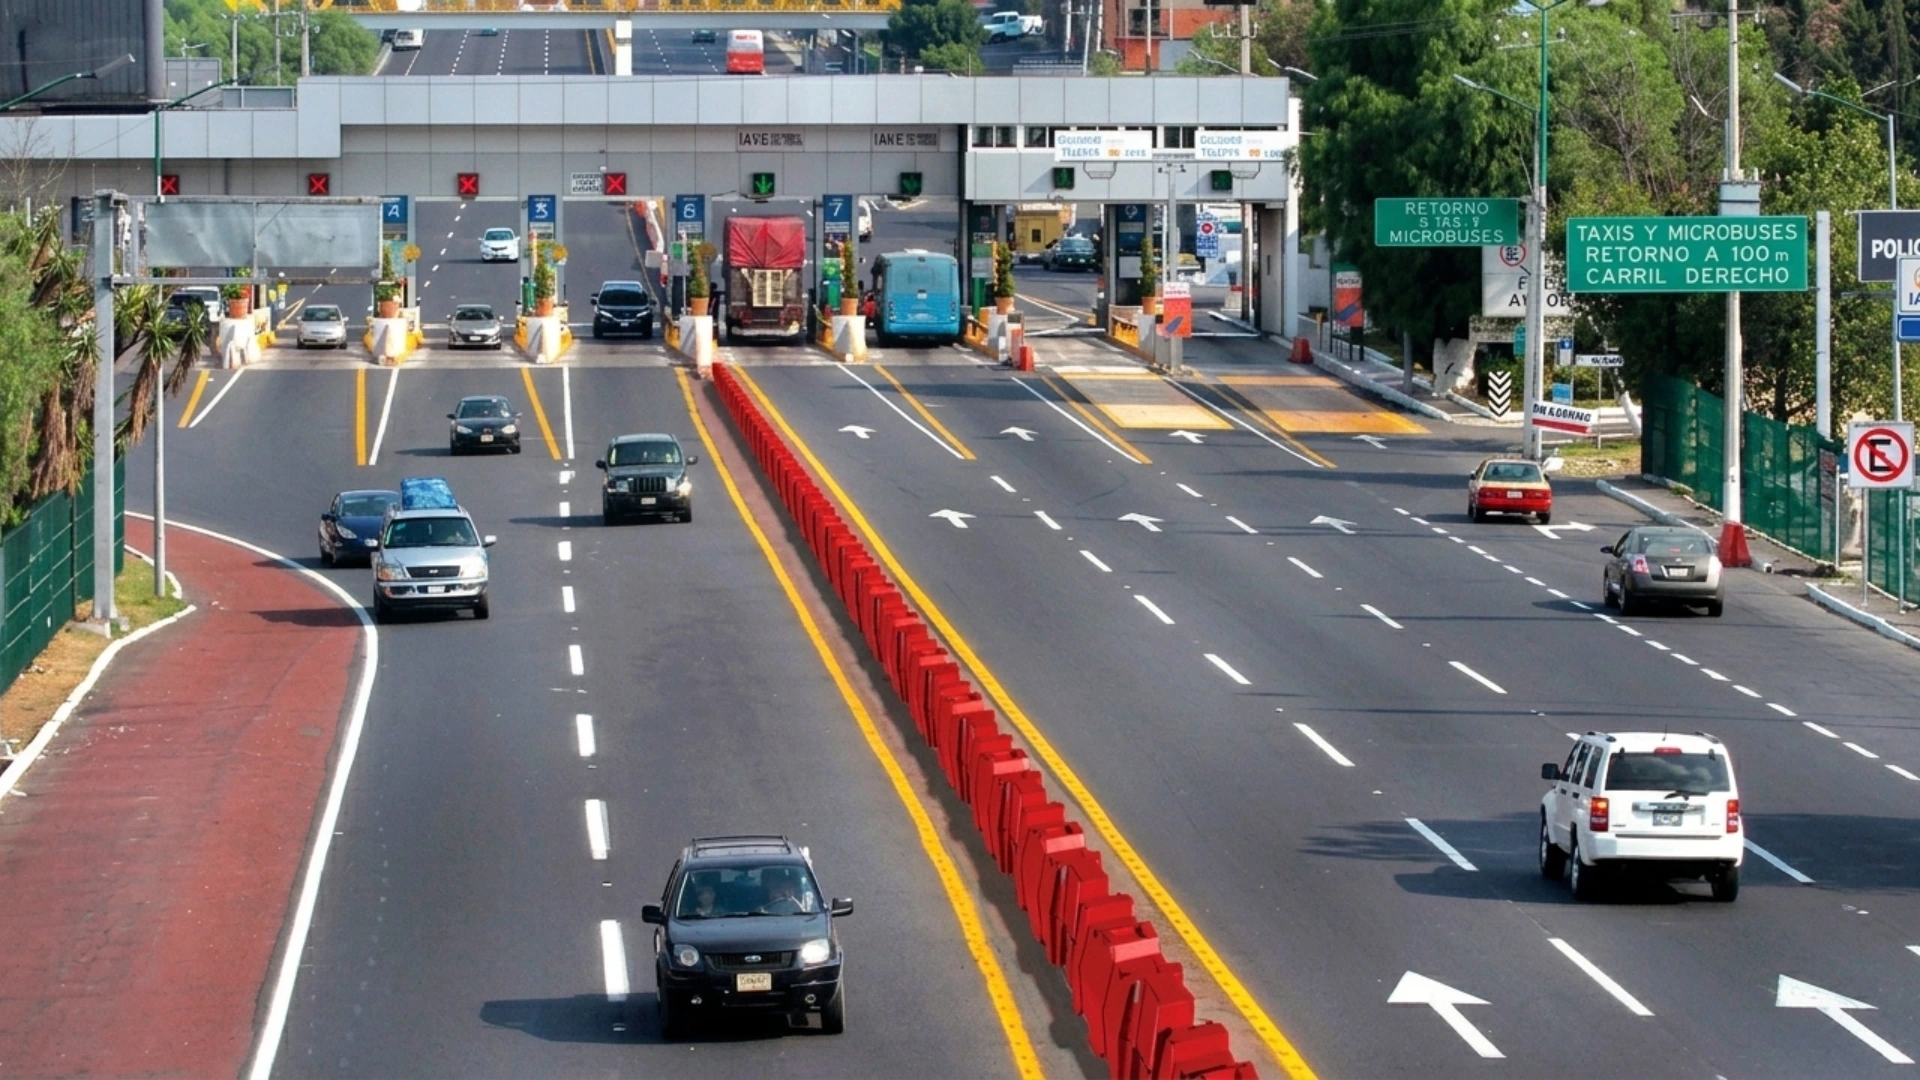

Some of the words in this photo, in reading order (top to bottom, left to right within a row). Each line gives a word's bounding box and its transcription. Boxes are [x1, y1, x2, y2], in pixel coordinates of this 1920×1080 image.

[1405, 202, 1489, 215] RETORNO
[1390, 229, 1504, 243] MICROBUSES
[1577, 225, 1634, 241] TAXIS
[1643, 225, 1658, 241] Y
[1668, 224, 1798, 241] MICROBUSES
[1586, 246, 1690, 262] RETORNO
[1704, 246, 1719, 262] A
[1731, 245, 1769, 262] 100
[1775, 251, 1789, 261] m
[1586, 267, 1667, 284] CARRIL
[1686, 267, 1790, 284] DERECHO
